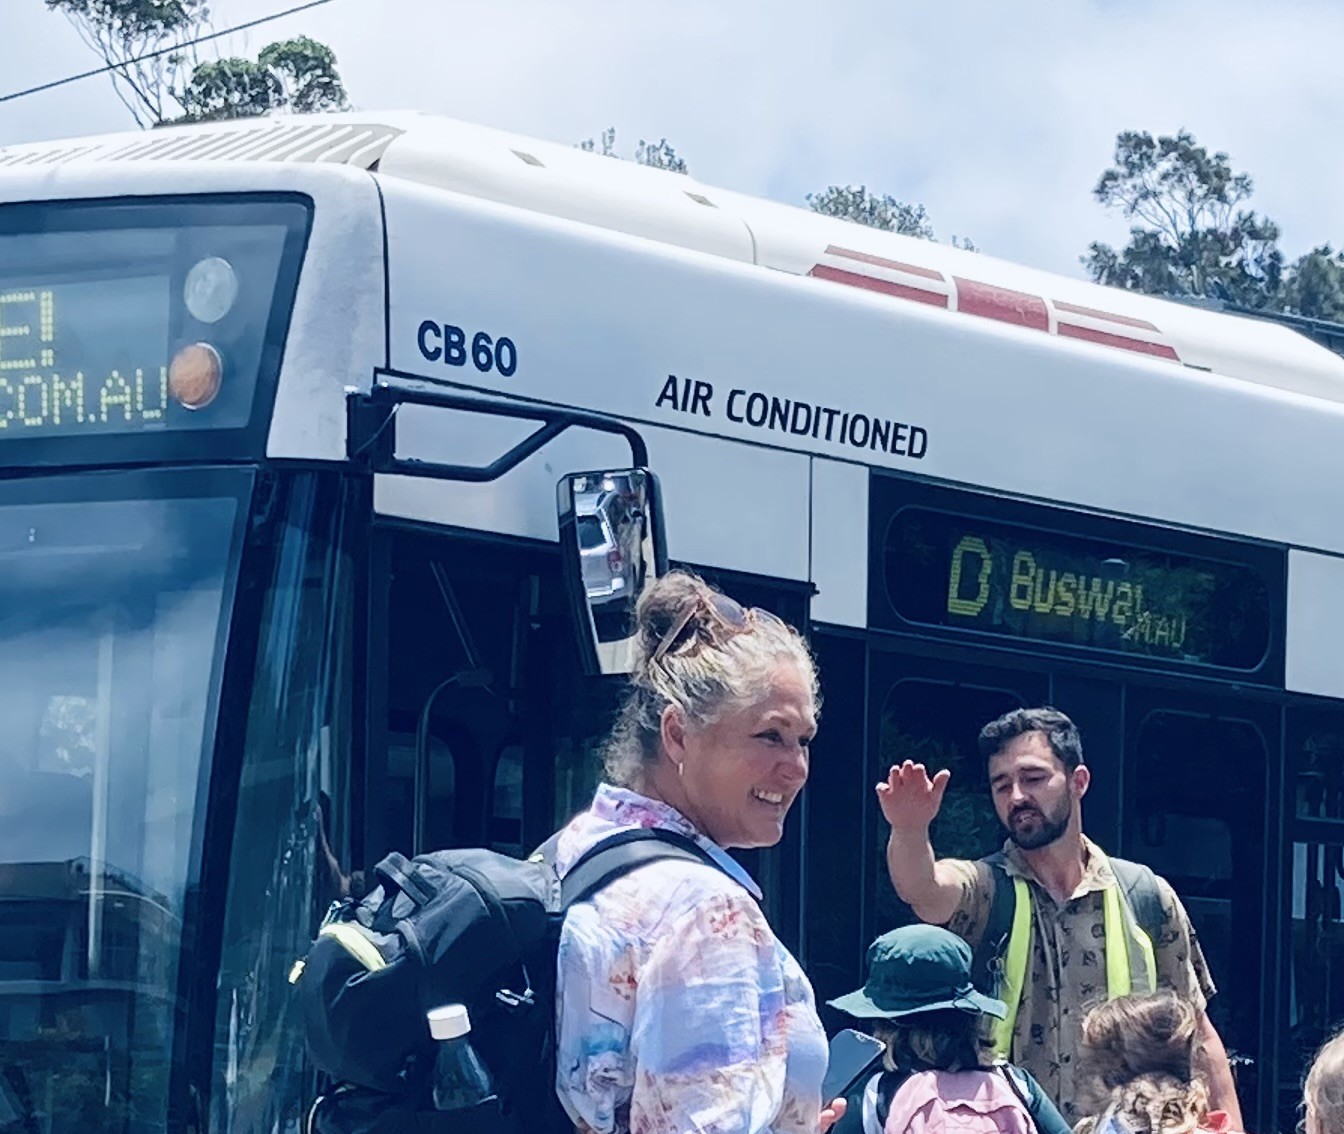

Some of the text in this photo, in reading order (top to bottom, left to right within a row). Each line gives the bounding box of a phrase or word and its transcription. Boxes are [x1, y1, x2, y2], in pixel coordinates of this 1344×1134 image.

[417, 319, 517, 377] CB60
[656, 374, 928, 459] AIR CONDITIONED
